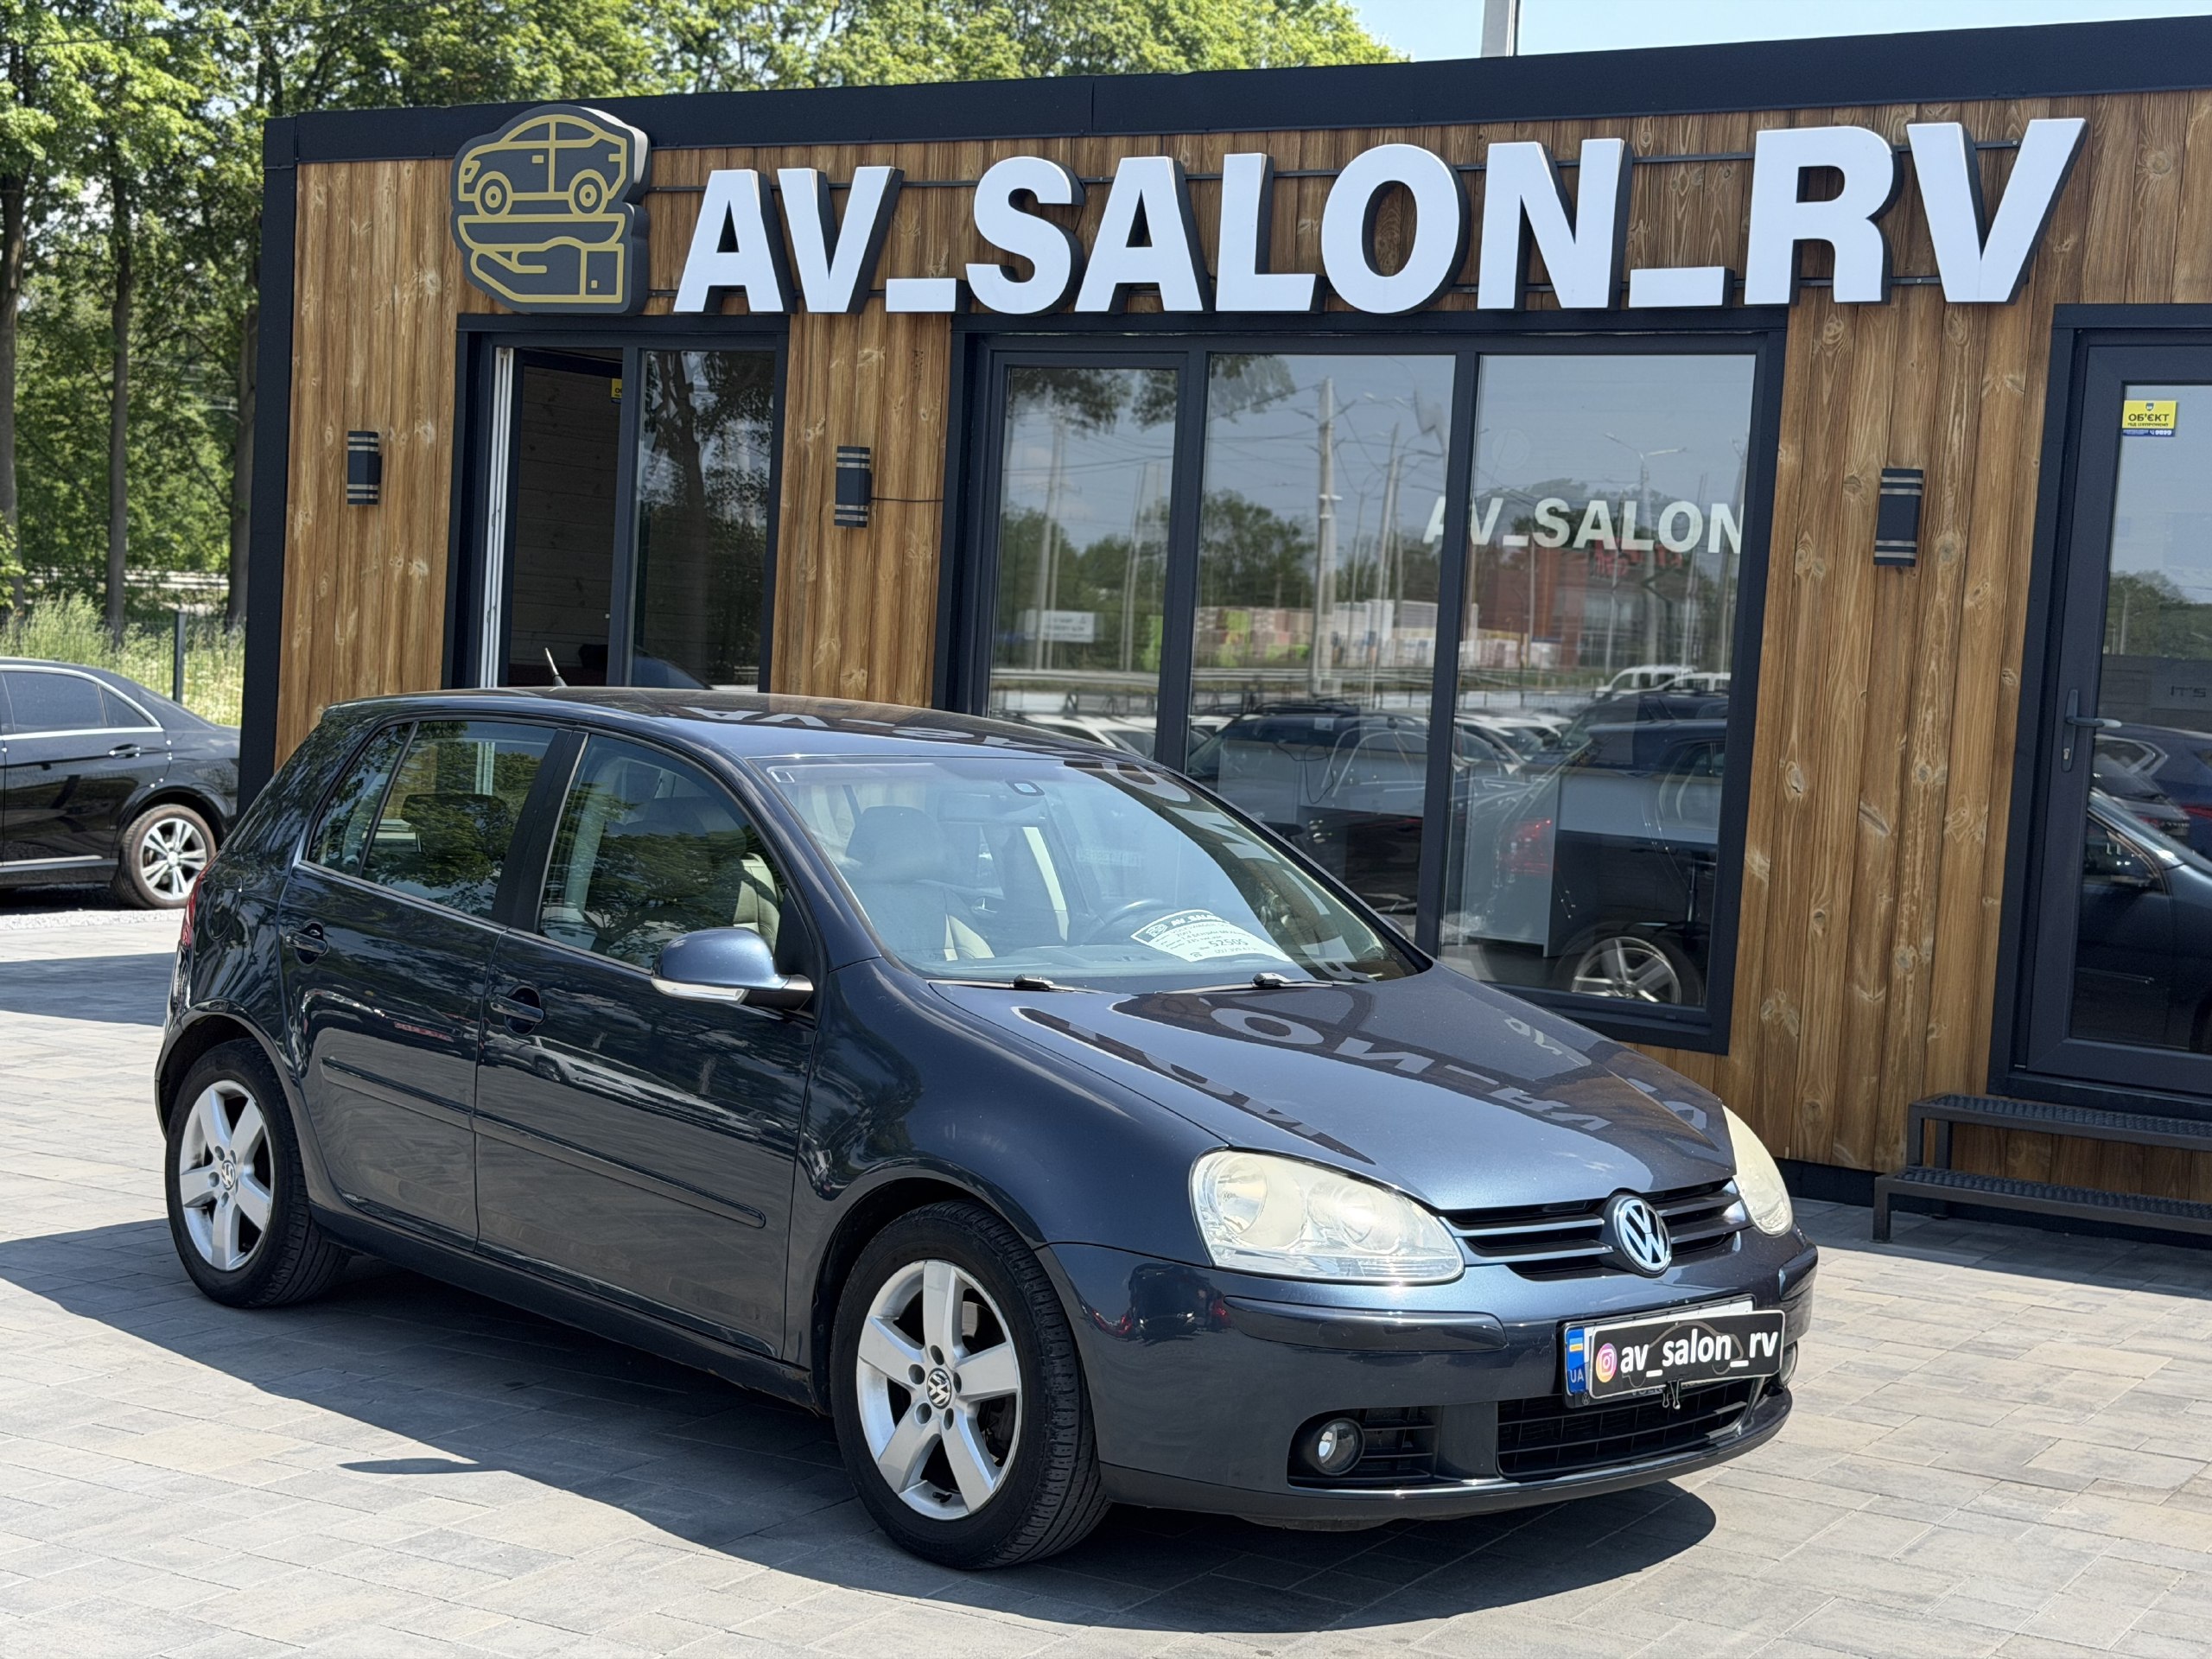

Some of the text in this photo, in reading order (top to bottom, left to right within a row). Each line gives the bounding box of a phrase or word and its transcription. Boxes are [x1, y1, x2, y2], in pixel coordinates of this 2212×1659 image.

[673, 118, 2086, 315] AV_SALON_RV
[2128, 413, 2170, 422] ОБ'ЄКТ
[1619, 1328, 1779, 1377] av_salon_rv
[1570, 1368, 1585, 1383] UA
